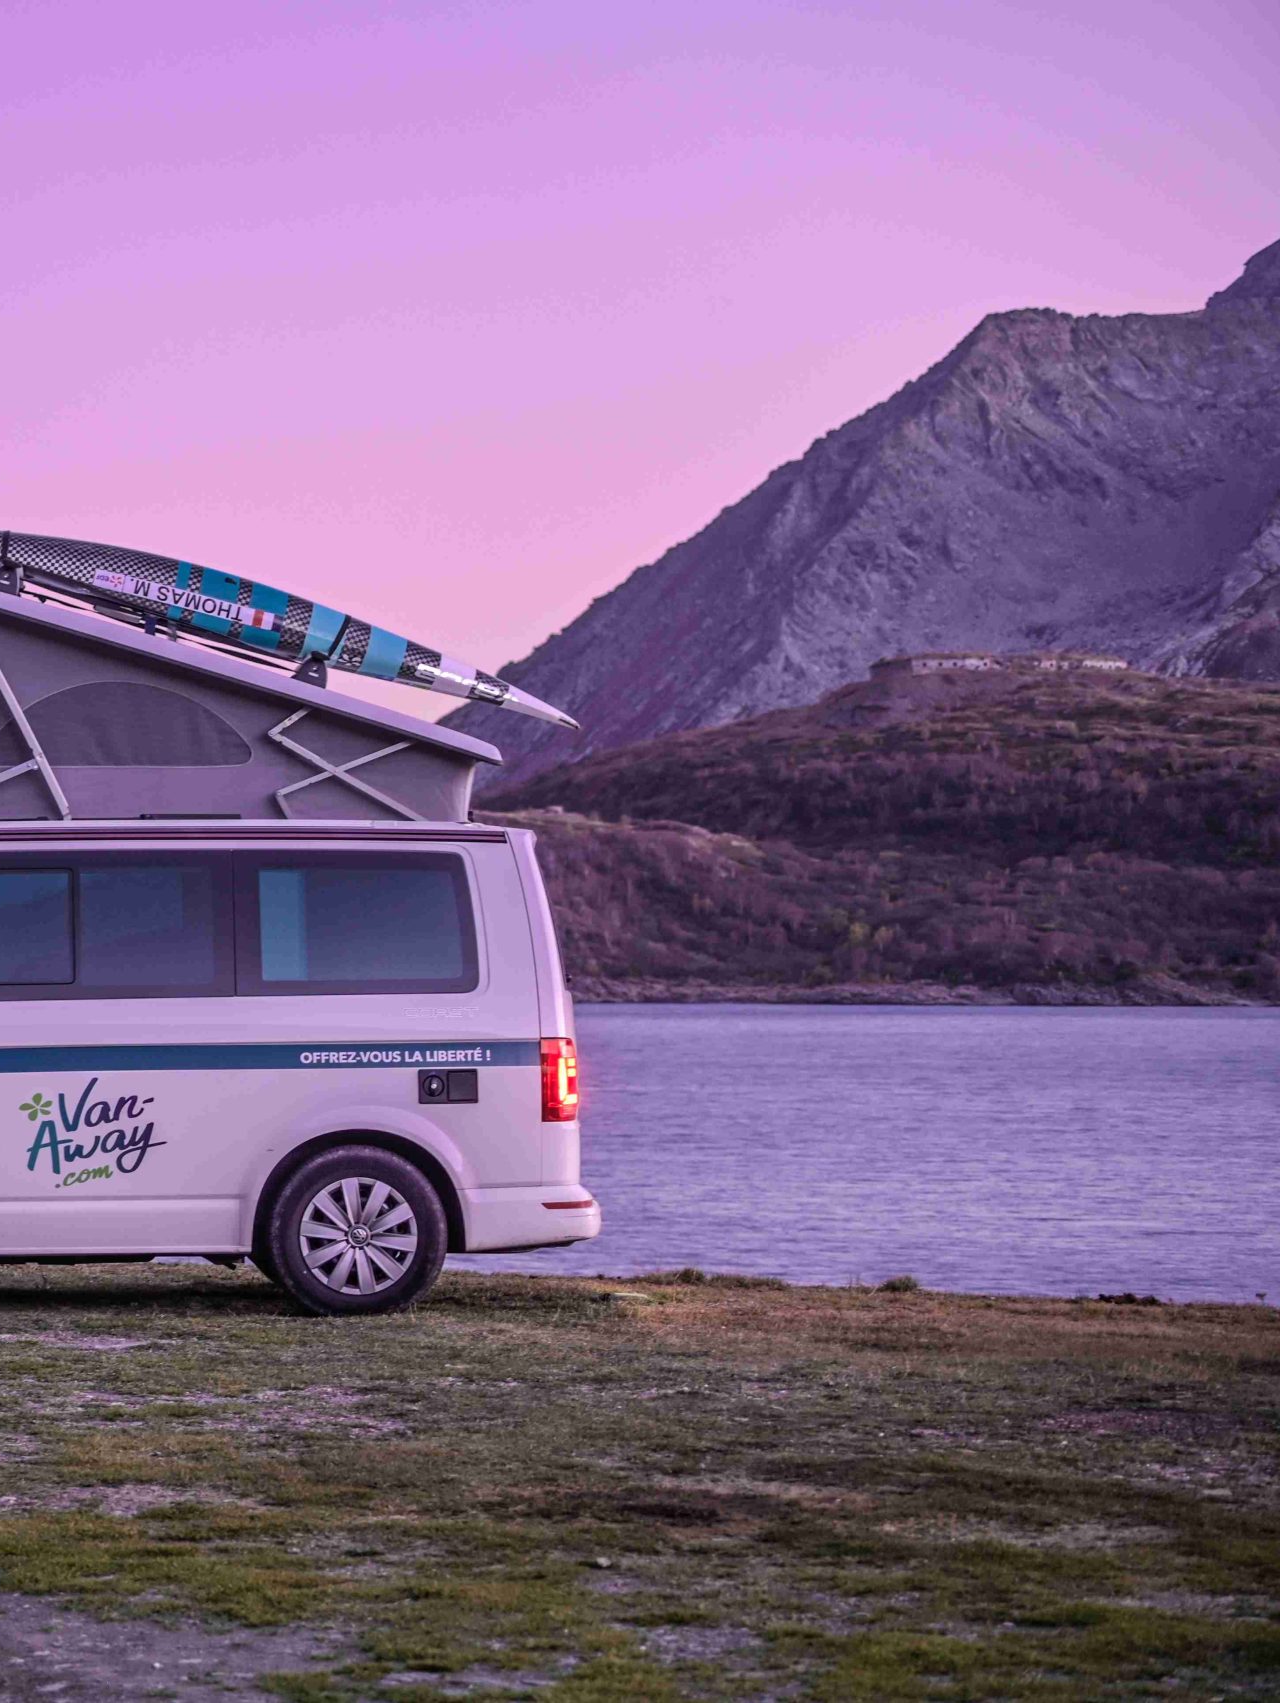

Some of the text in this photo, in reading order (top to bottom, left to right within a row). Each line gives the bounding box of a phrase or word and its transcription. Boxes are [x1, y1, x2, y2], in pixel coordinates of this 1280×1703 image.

[129, 578, 242, 622] THOMAS M.
[300, 1047, 491, 1064] OFFREZ-VOUS LA LIBERTÉ !
[58, 1077, 154, 1132] Van-
[26, 1120, 167, 1174] Away
[55, 1164, 113, 1188] .com
